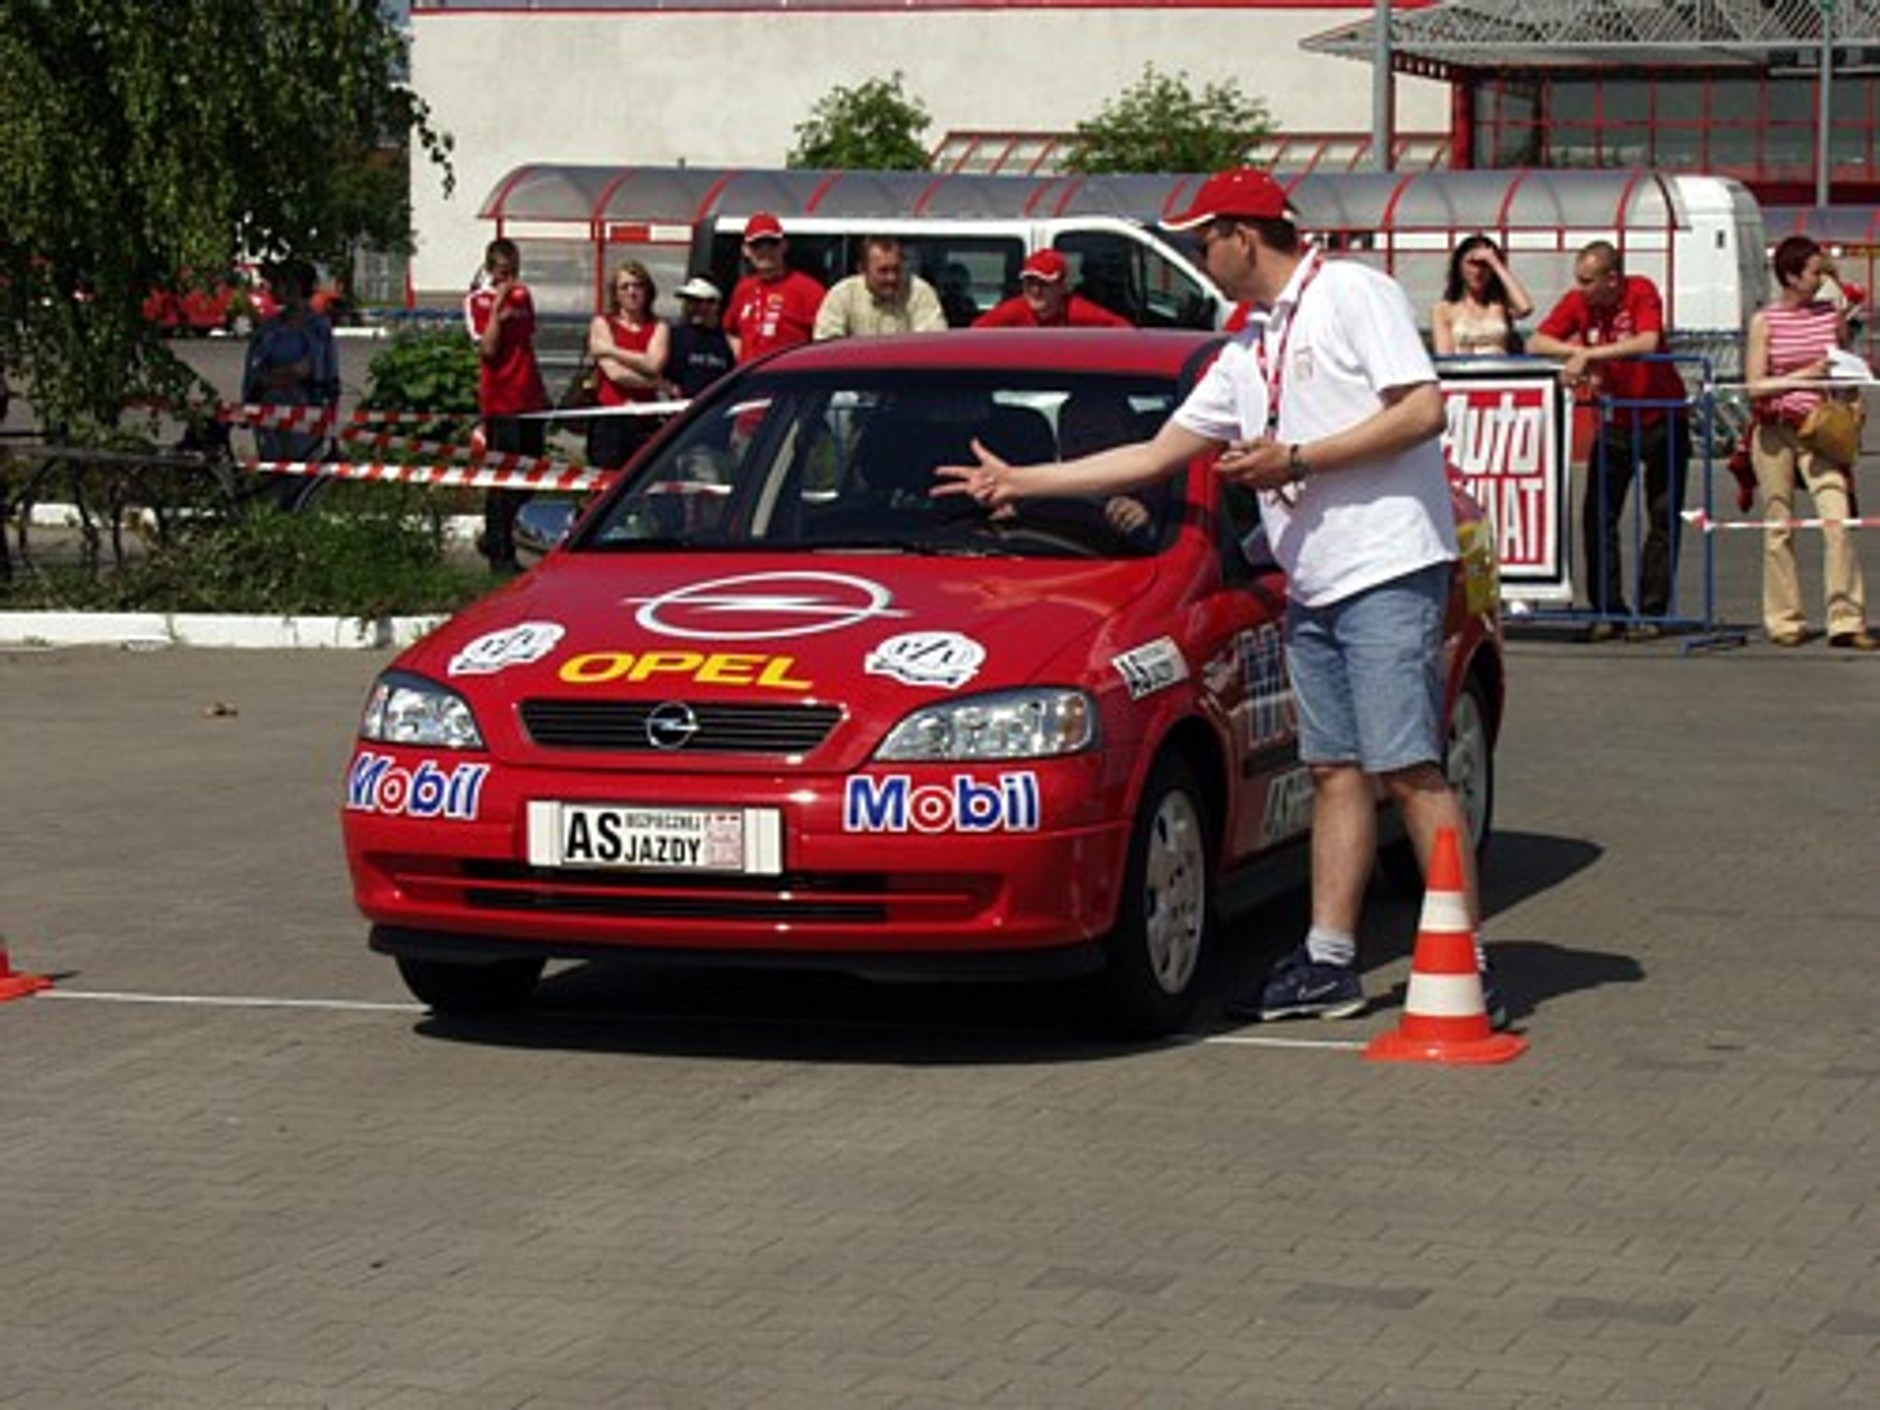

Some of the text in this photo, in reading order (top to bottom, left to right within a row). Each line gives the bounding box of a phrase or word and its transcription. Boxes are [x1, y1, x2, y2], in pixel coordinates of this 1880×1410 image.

[557, 652, 813, 690] OPEL
[349, 755, 488, 820] Mobil
[845, 772, 1039, 832] Mobil
[567, 812, 622, 860] AS
[625, 834, 700, 863] JAZDY
